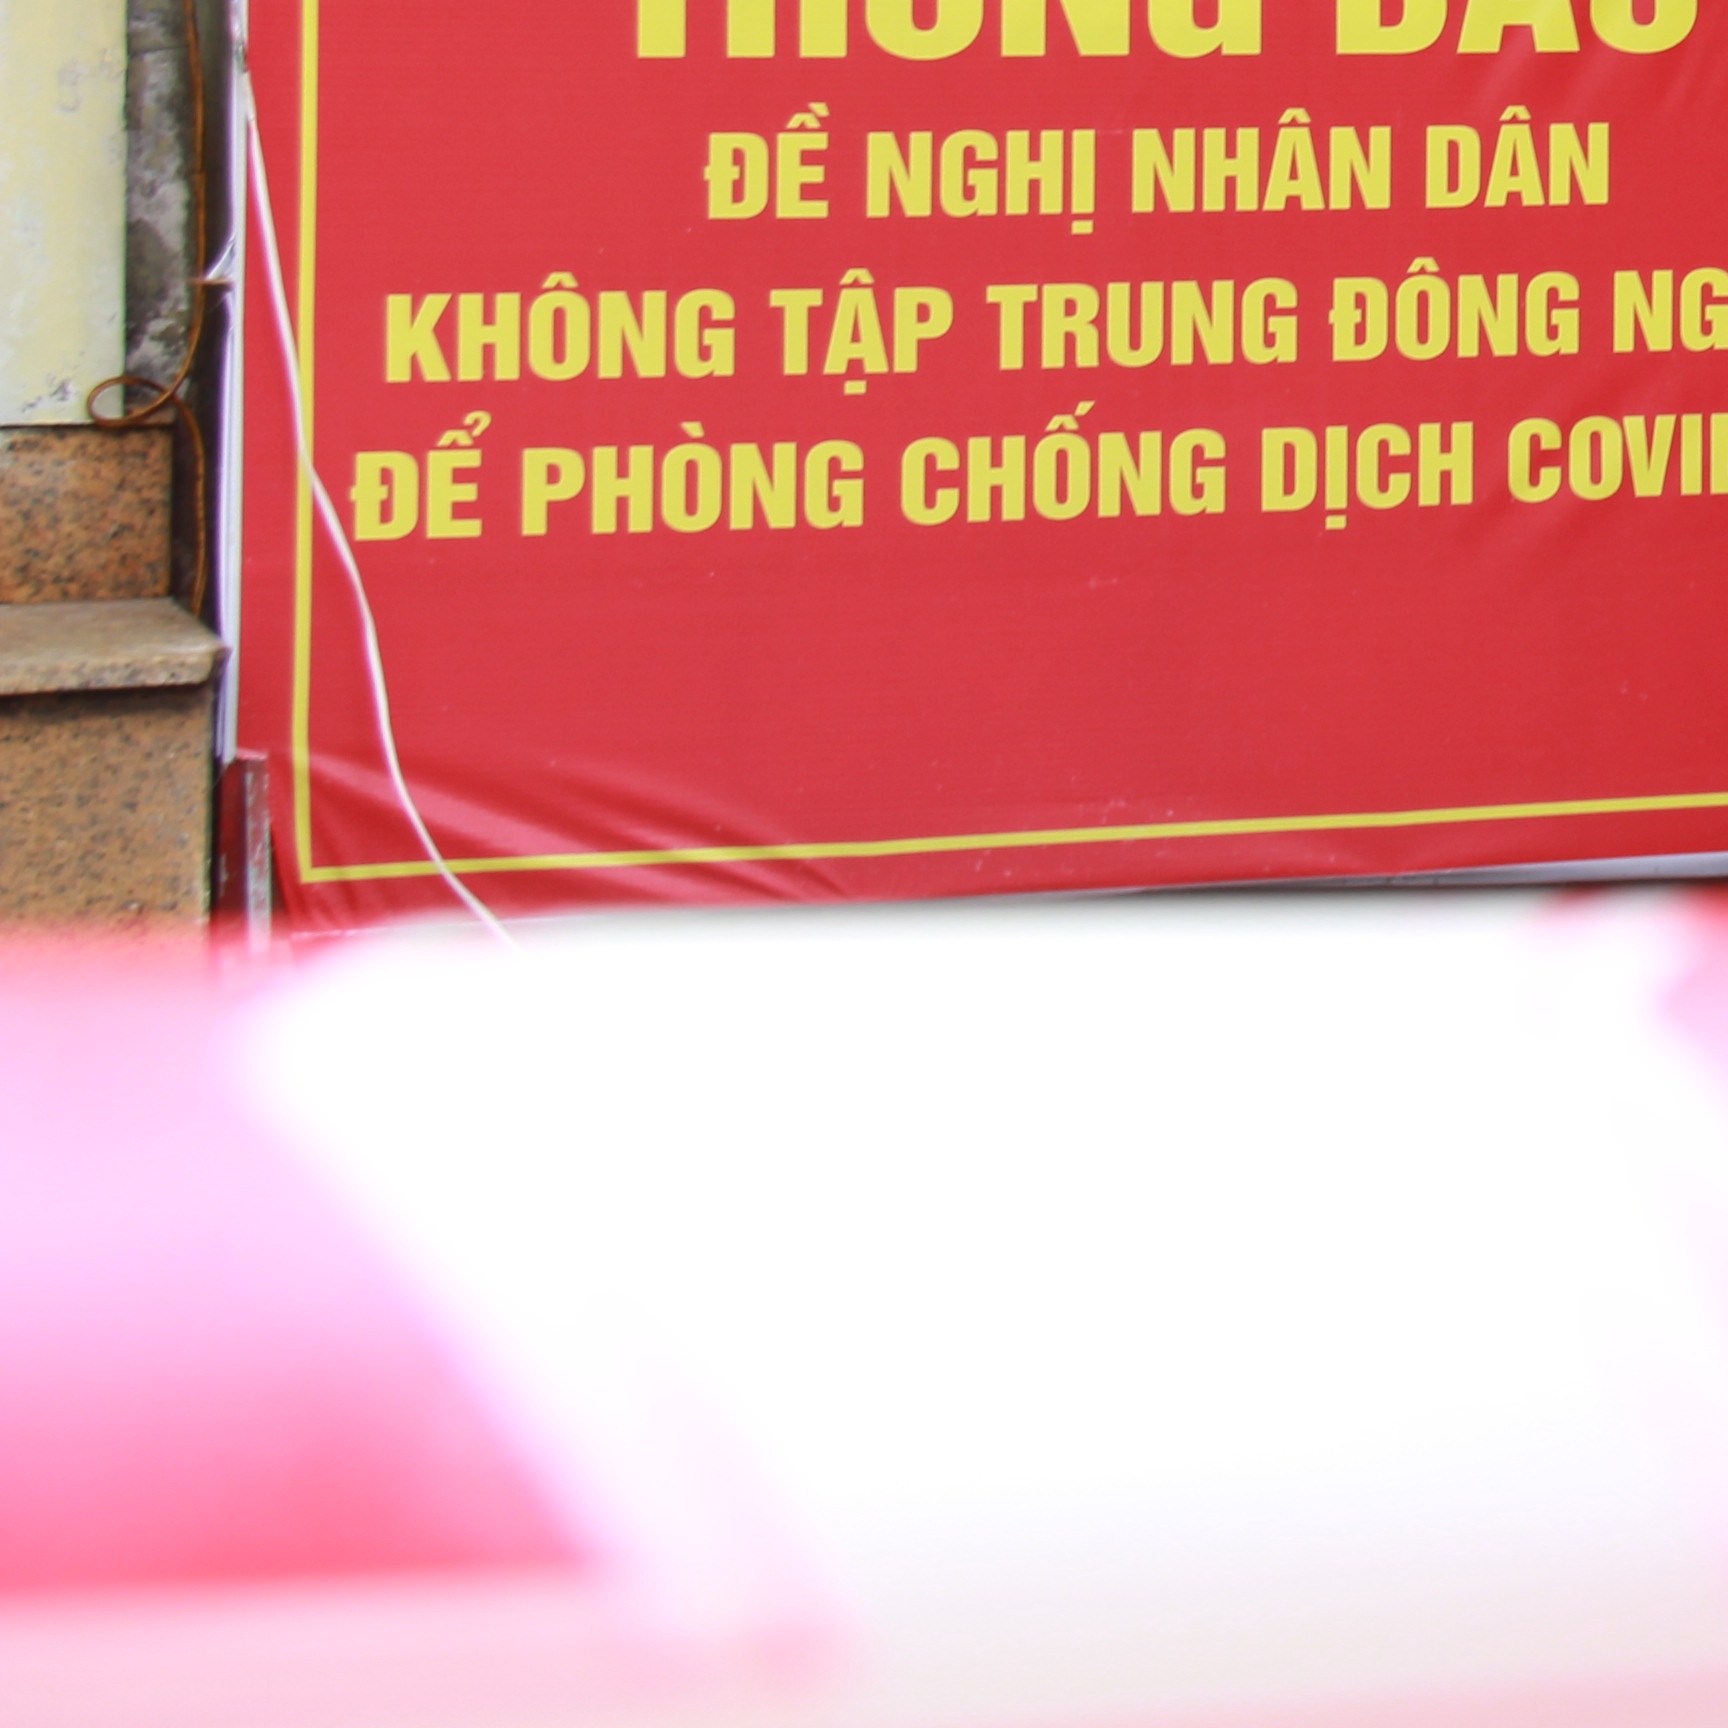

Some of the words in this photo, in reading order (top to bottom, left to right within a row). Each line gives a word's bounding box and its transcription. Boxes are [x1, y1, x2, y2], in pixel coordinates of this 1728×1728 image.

[703, 102, 830, 220] ĐỀ
[866, 129, 1096, 235] NGHỊ
[1131, 107, 1392, 213] NHÂN
[1425, 105, 1610, 209] DÂN
[385, 271, 735, 383] KHÔNG
[769, 268, 954, 395] TẬP
[985, 277, 1298, 370] TRUNG
[1328, 256, 1580, 362] ĐÔNG
[349, 410, 492, 541] ĐỂ
[521, 421, 864, 536] PHÒNG
[900, 400, 1226, 526] CHỐNG
[1261, 421, 1474, 530] DỊCH
